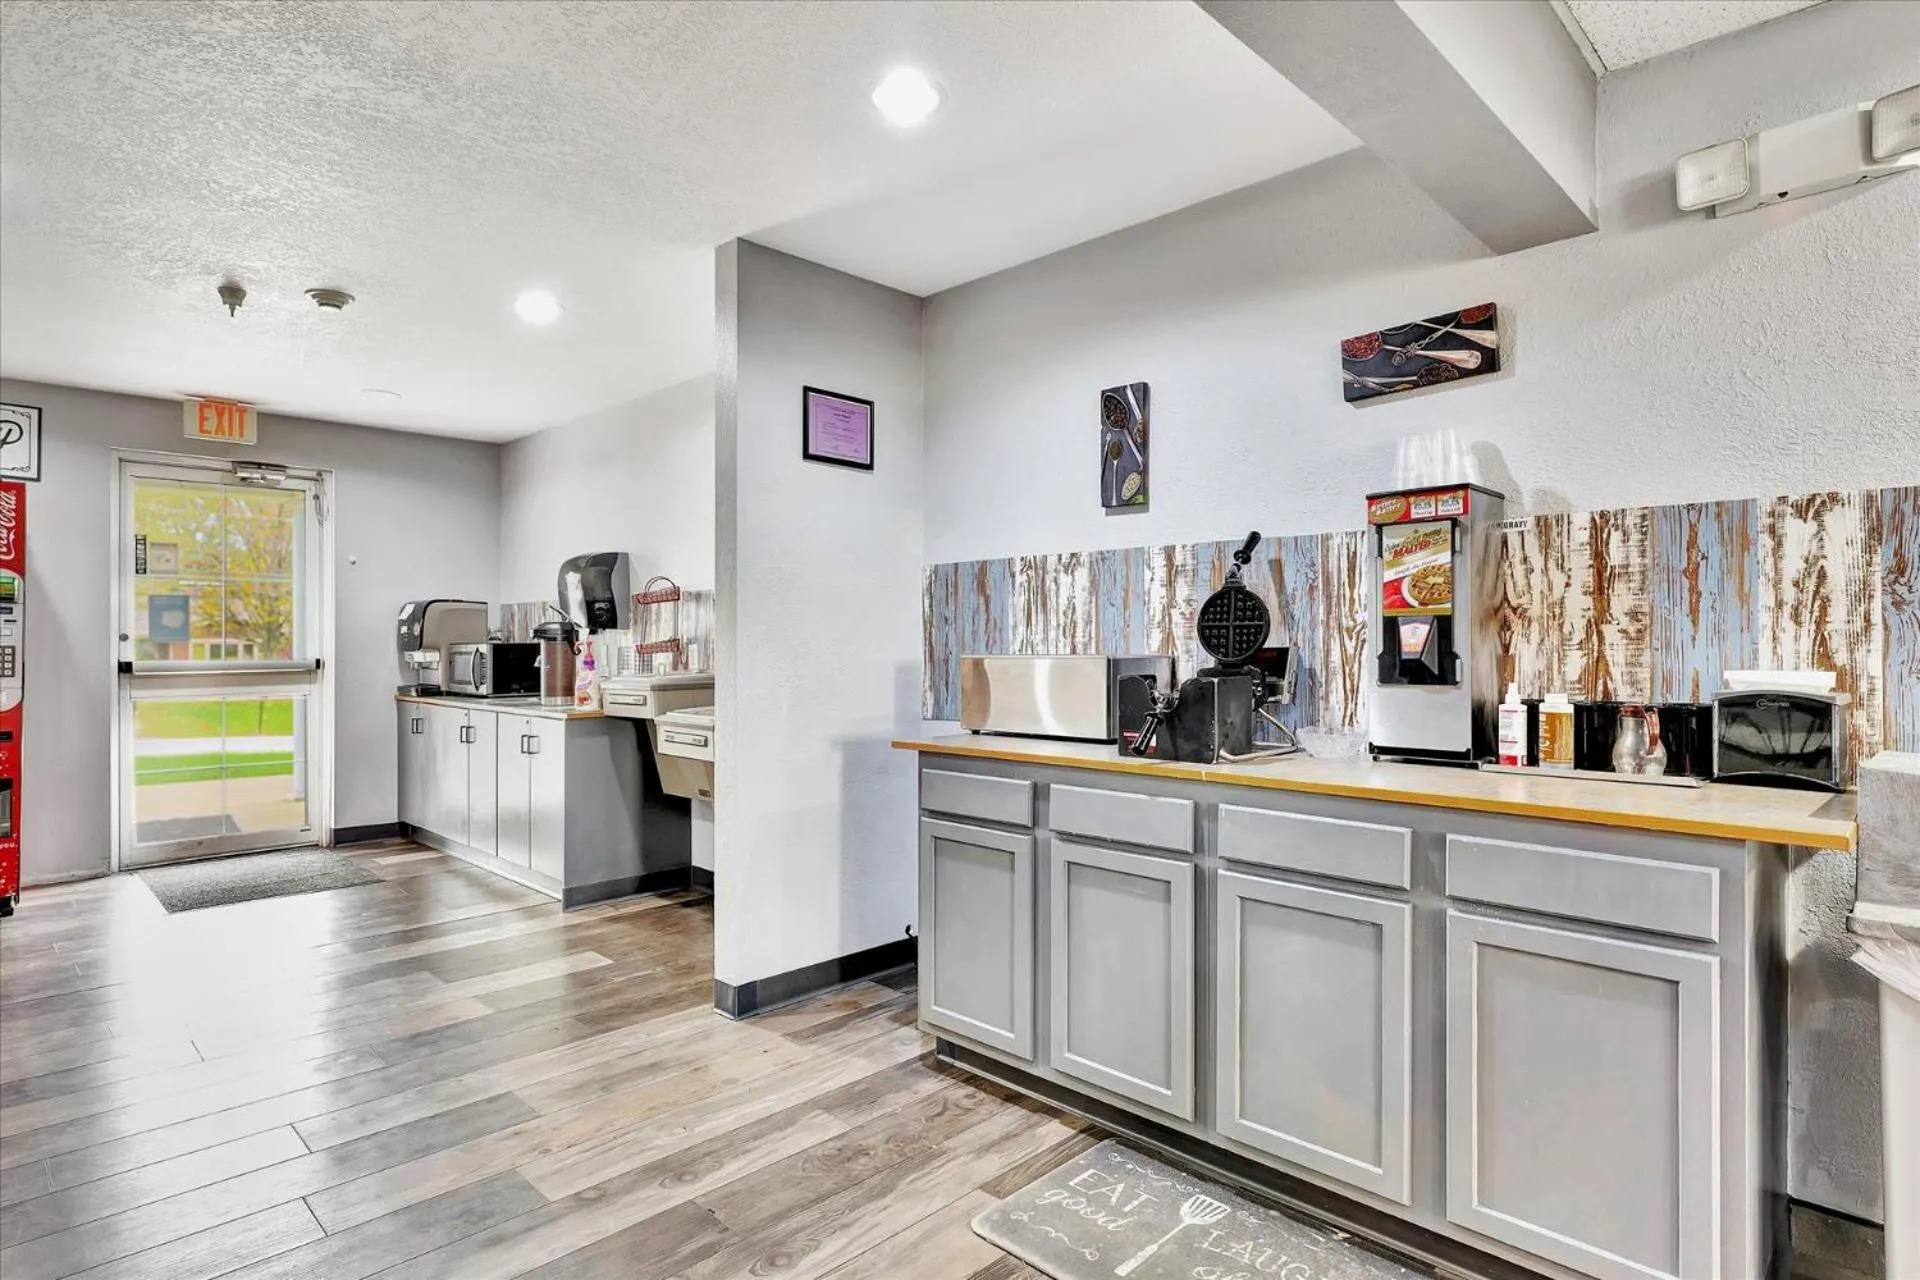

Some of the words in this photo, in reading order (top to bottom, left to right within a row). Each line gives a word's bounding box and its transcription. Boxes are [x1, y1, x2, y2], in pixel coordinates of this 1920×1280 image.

[197, 401, 248, 438] EXIT
[1034, 1189, 1139, 1231] good
[1067, 1167, 1160, 1213] EAT
[1201, 1229, 1327, 1280] LAUG
